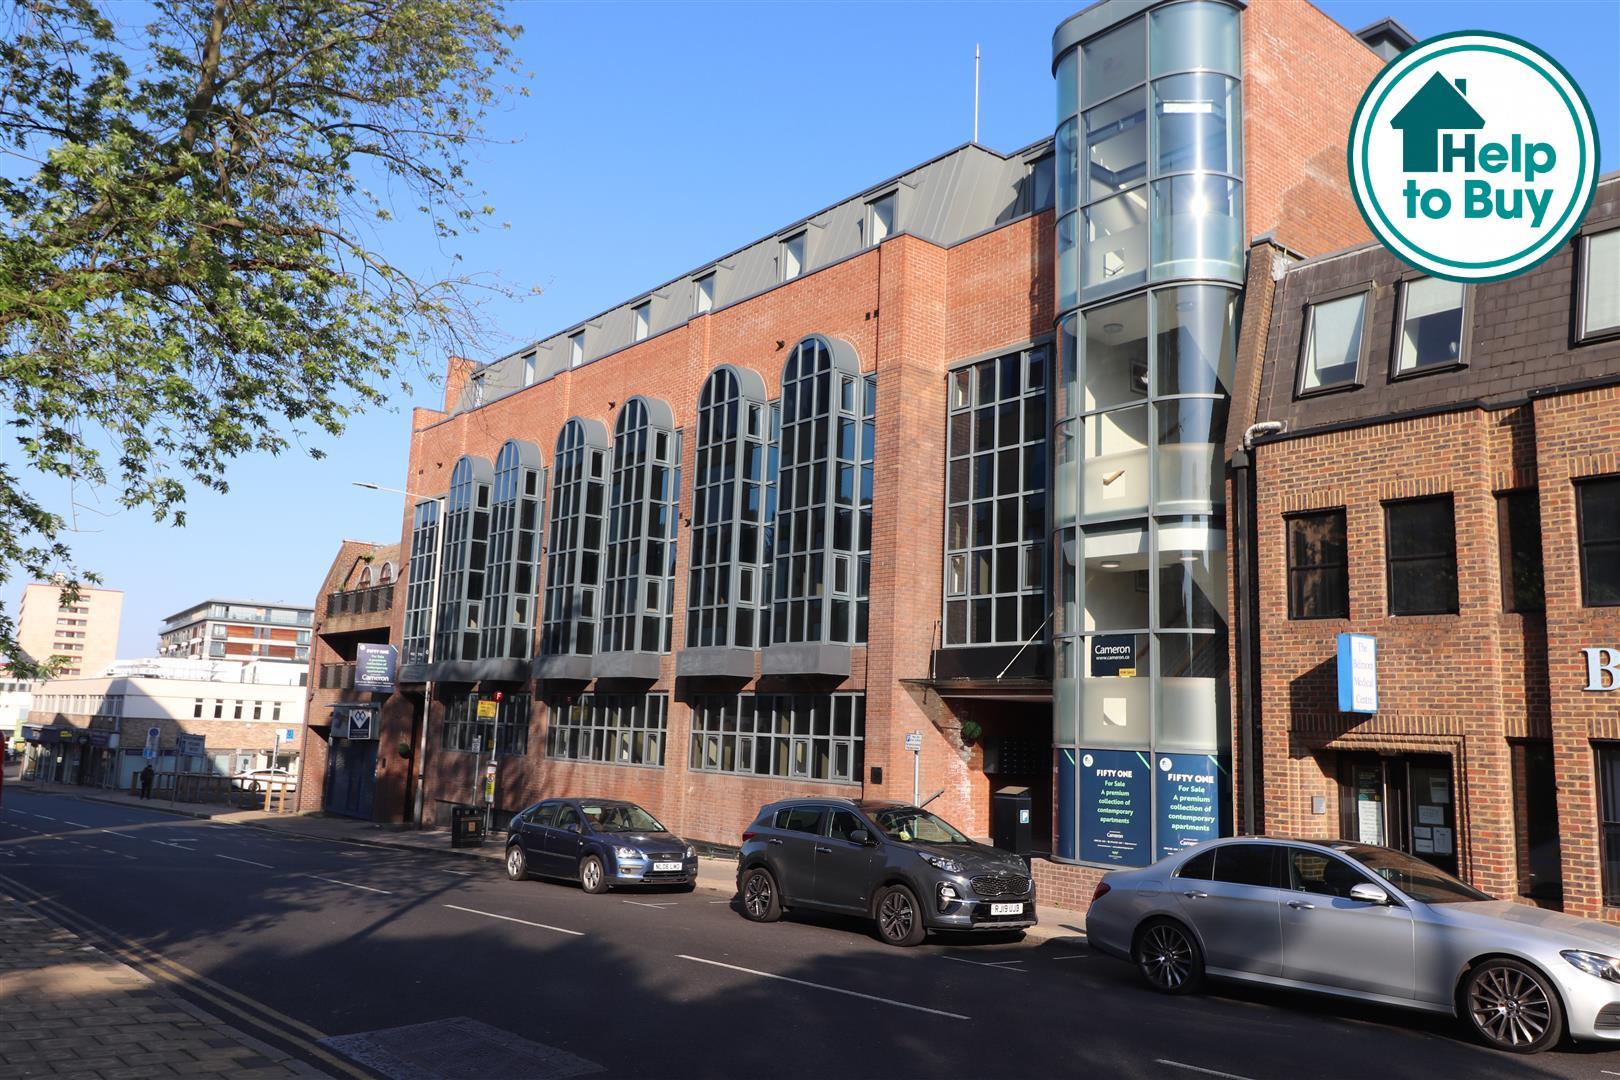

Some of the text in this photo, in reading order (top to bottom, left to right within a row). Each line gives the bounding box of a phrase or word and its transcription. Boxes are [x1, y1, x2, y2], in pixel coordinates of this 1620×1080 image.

[1094, 644, 1130, 654] Cameron
[1096, 769, 1132, 778] FIFTY ONE
[1168, 773, 1214, 784] FIFTY ONE
[1179, 795, 1210, 803] premium
[1097, 808, 1134, 816] contemporary
[1170, 804, 1203, 812] collection
[1168, 813, 1215, 824] contemporary
[1171, 823, 1210, 832] apartments
